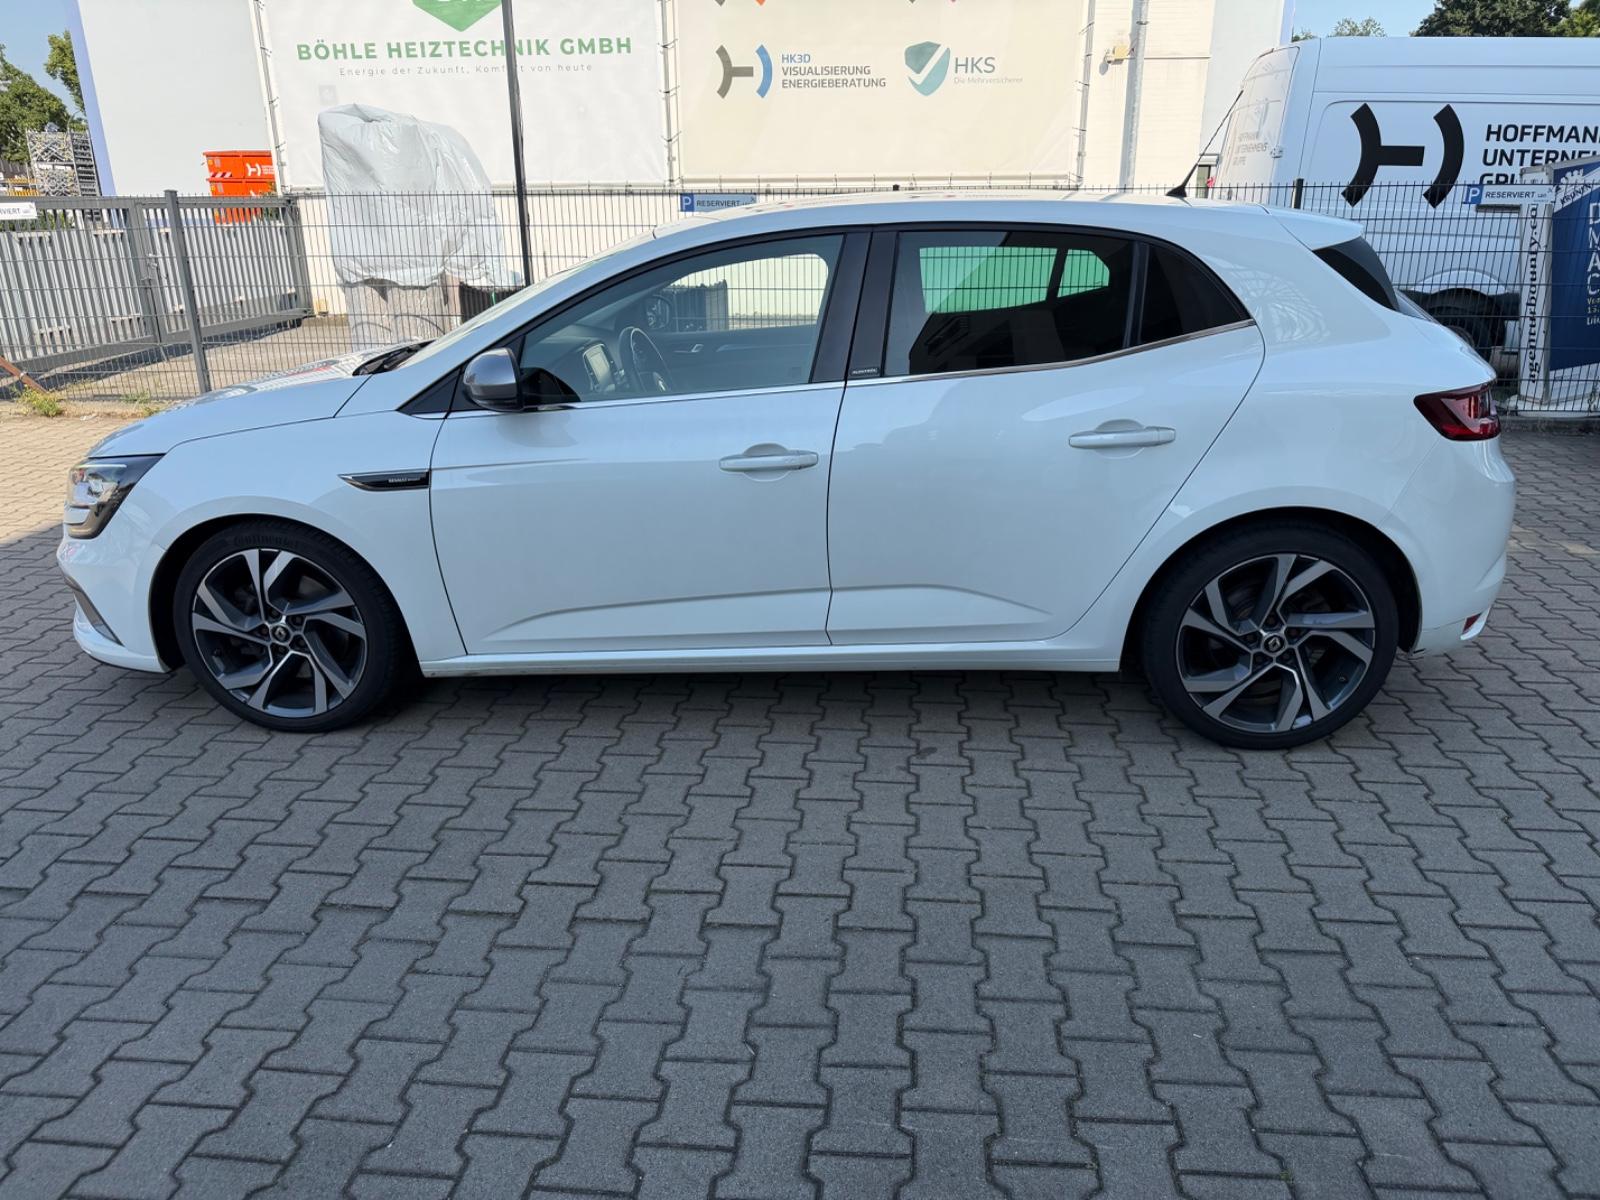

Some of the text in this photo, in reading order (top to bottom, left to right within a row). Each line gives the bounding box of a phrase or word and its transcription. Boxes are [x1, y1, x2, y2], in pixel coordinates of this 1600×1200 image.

[297, 39, 378, 60] BÖHLE
[559, 37, 633, 55] GMBH
[781, 53, 811, 64] HK3D
[339, 67, 385, 78] Energie
[392, 66, 411, 75] der
[530, 65, 551, 73] von
[557, 63, 593, 72] heute
[781, 65, 871, 76] VISUALISIERUNG
[954, 56, 996, 74] HKS
[781, 77, 887, 89] ENERGIEBERATUNG
[1485, 191, 1535, 199] RESERVIERT
